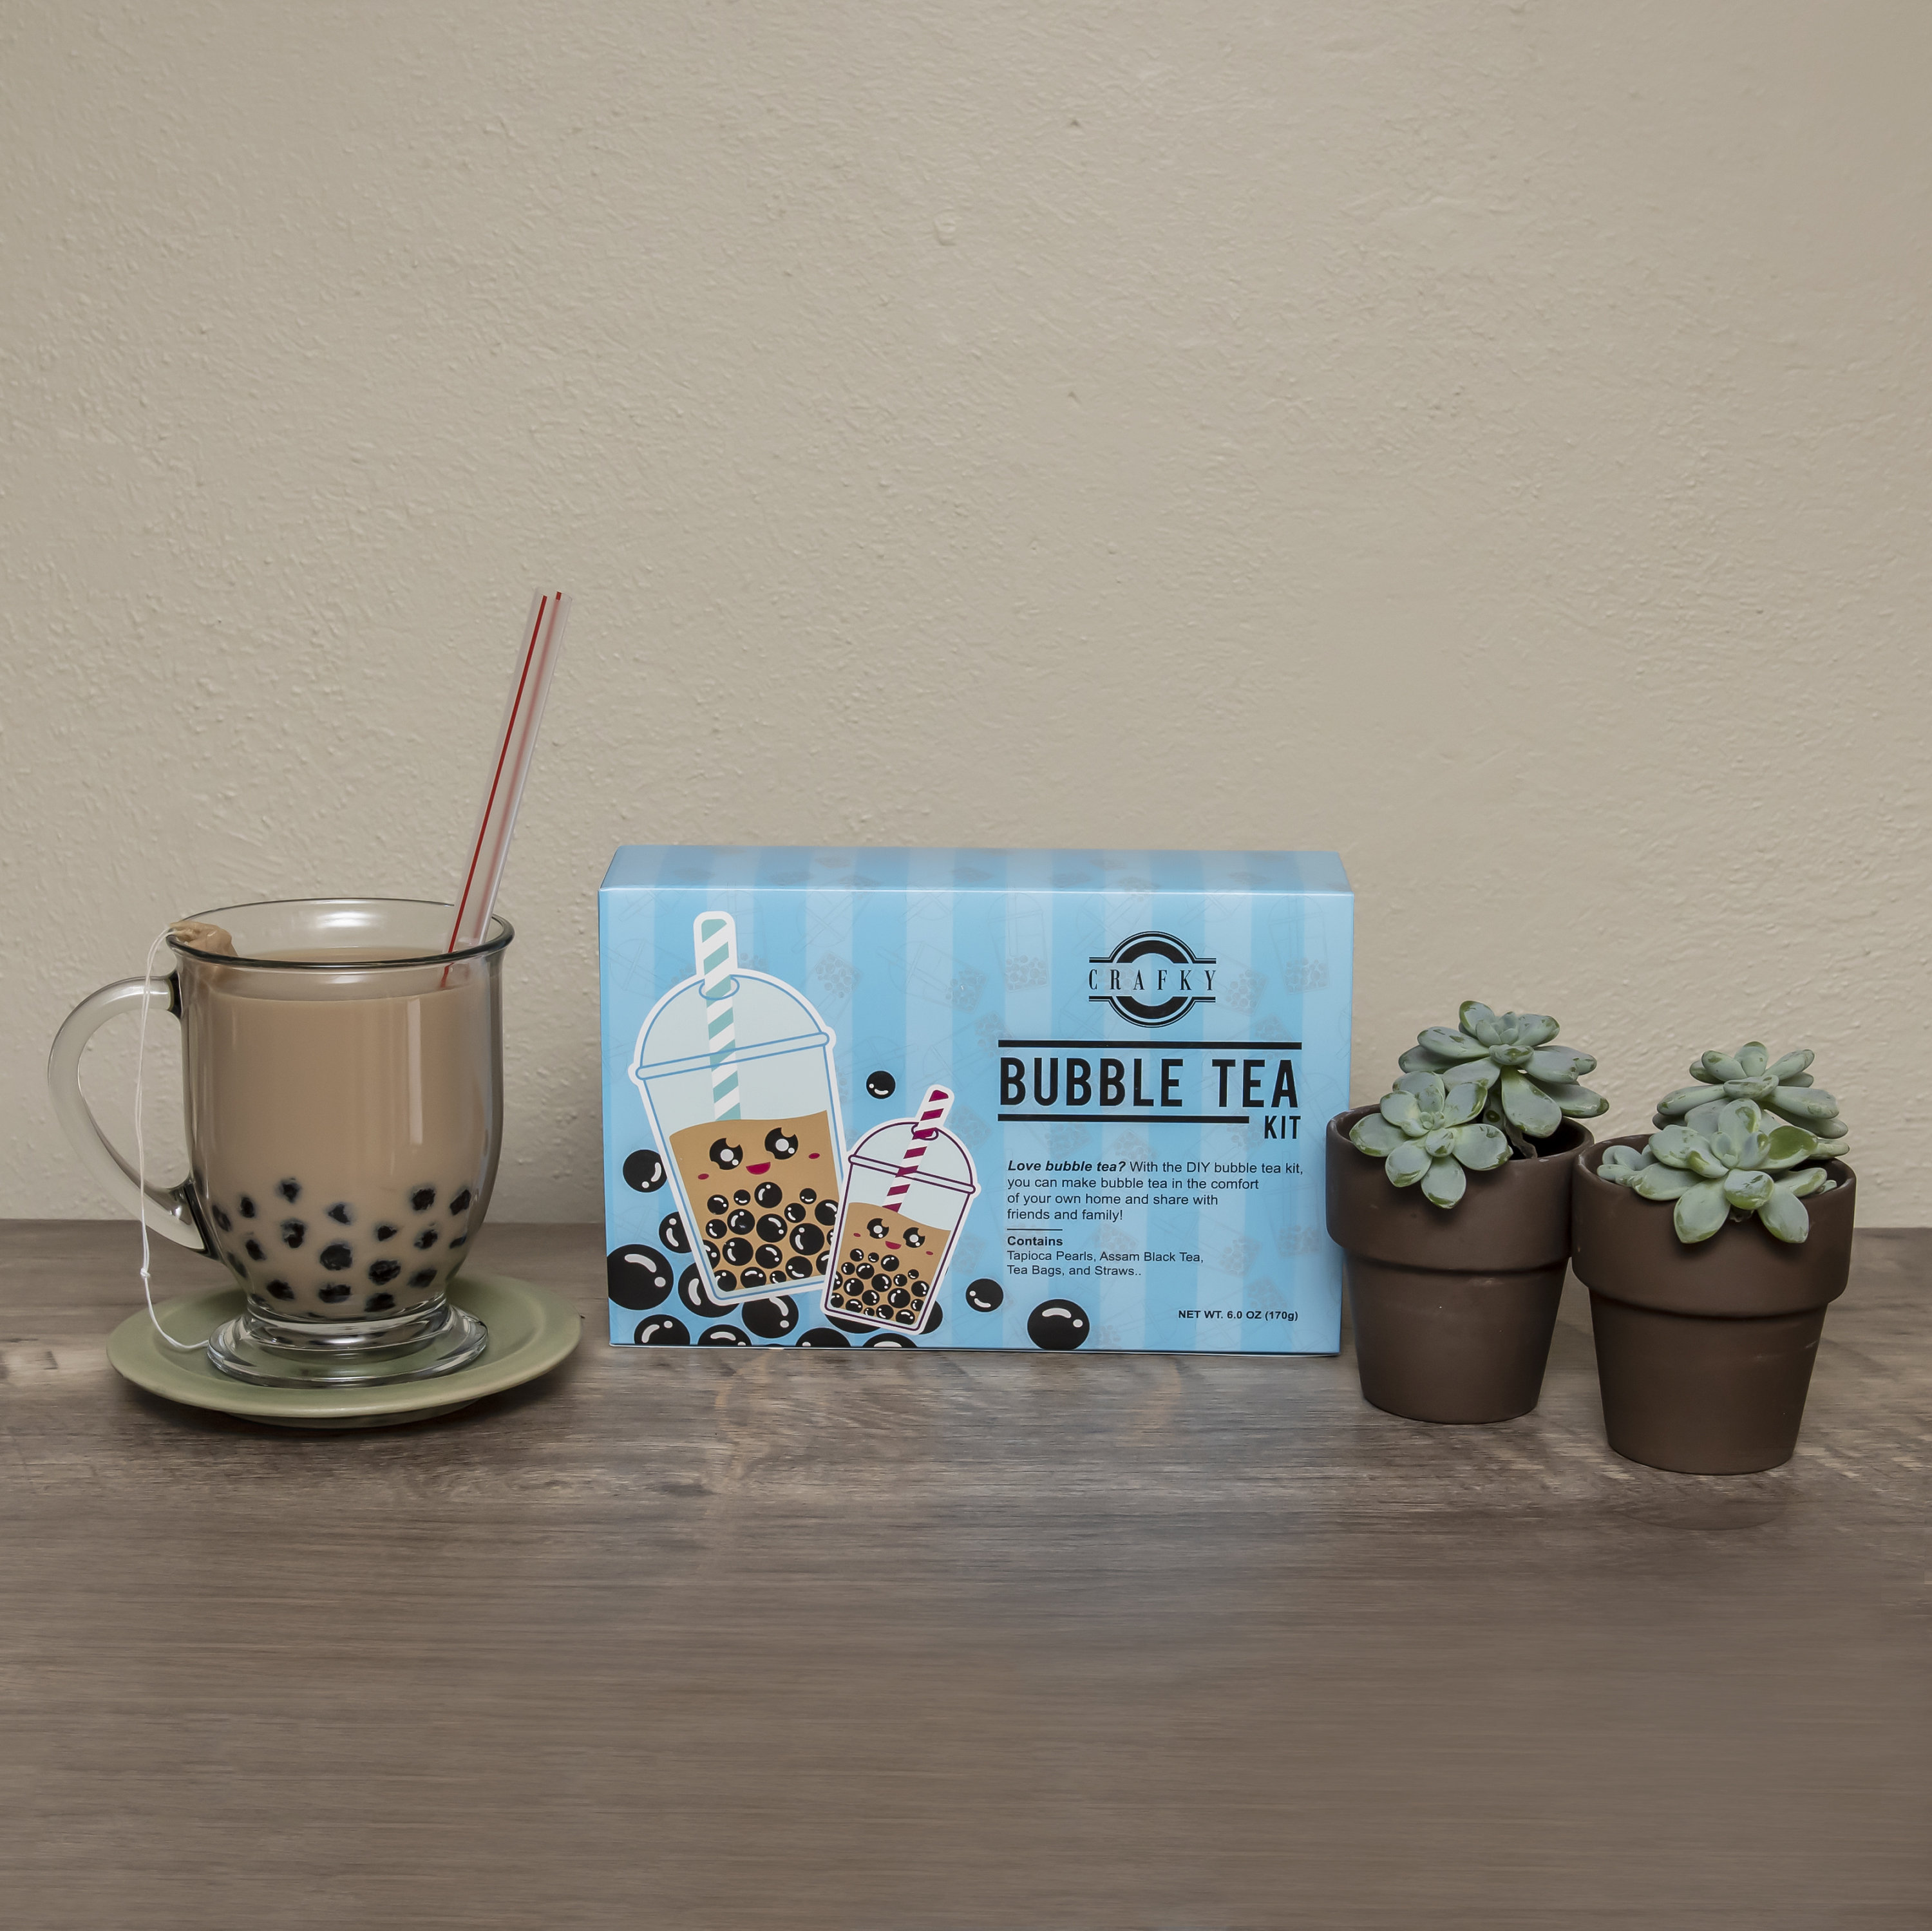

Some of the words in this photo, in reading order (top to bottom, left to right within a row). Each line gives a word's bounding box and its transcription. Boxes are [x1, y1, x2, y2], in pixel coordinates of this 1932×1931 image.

[1088, 968, 1216, 992] CRAFKY
[999, 1057, 1184, 1107] BUBBLE
[1211, 1058, 1299, 1109] TEA
[1264, 1115, 1302, 1140] KIT
[1007, 1159, 1042, 1172] Love
[1045, 1160, 1094, 1173] bubble
[1096, 1160, 1127, 1173] tea?
[1129, 1160, 1159, 1173] With
[1161, 1161, 1183, 1173] the
[1186, 1161, 1211, 1173] DIY
[1213, 1161, 1258, 1174] bubble
[1260, 1162, 1282, 1174] tea
[1285, 1162, 1303, 1176] kit,
[1007, 1178, 1030, 1191] you
[1034, 1178, 1058, 1188] can
[1061, 1176, 1097, 1189] make
[1100, 1176, 1144, 1189] bubble
[1147, 1178, 1168, 1189] tea
[1171, 1177, 1183, 1189] in
[1186, 1177, 1208, 1190] the
[1210, 1178, 1260, 1190] comfort
[1007, 1192, 1021, 1204] of
[1022, 1194, 1052, 1207] your
[1054, 1194, 1081, 1205] own
[1084, 1192, 1122, 1205] home
[1124, 1193, 1150, 1205] and
[1152, 1193, 1189, 1205] share
[1192, 1194, 1218, 1206] with
[1006, 1207, 1051, 1220] friends
[1053, 1209, 1078, 1221] and
[1081, 1208, 1123, 1223] family!
[1007, 1235, 1064, 1247] Contains
[1006, 1250, 1052, 1263] Tapioca
[1056, 1250, 1097, 1263] Pearls,
[1099, 1250, 1141, 1262] Assam
[1143, 1251, 1177, 1263] Black
[1178, 1251, 1204, 1264] Tea,
[1006, 1264, 1028, 1276] Tea
[1031, 1264, 1065, 1278] Bags,
[1068, 1265, 1091, 1276] and
[1178, 1309, 1202, 1319] NET
[1203, 1310, 1224, 1319] WT.
[1226, 1310, 1244, 1320] 6.0
[1245, 1310, 1263, 1320] OZ
[1264, 1310, 1299, 1323] (170g)
